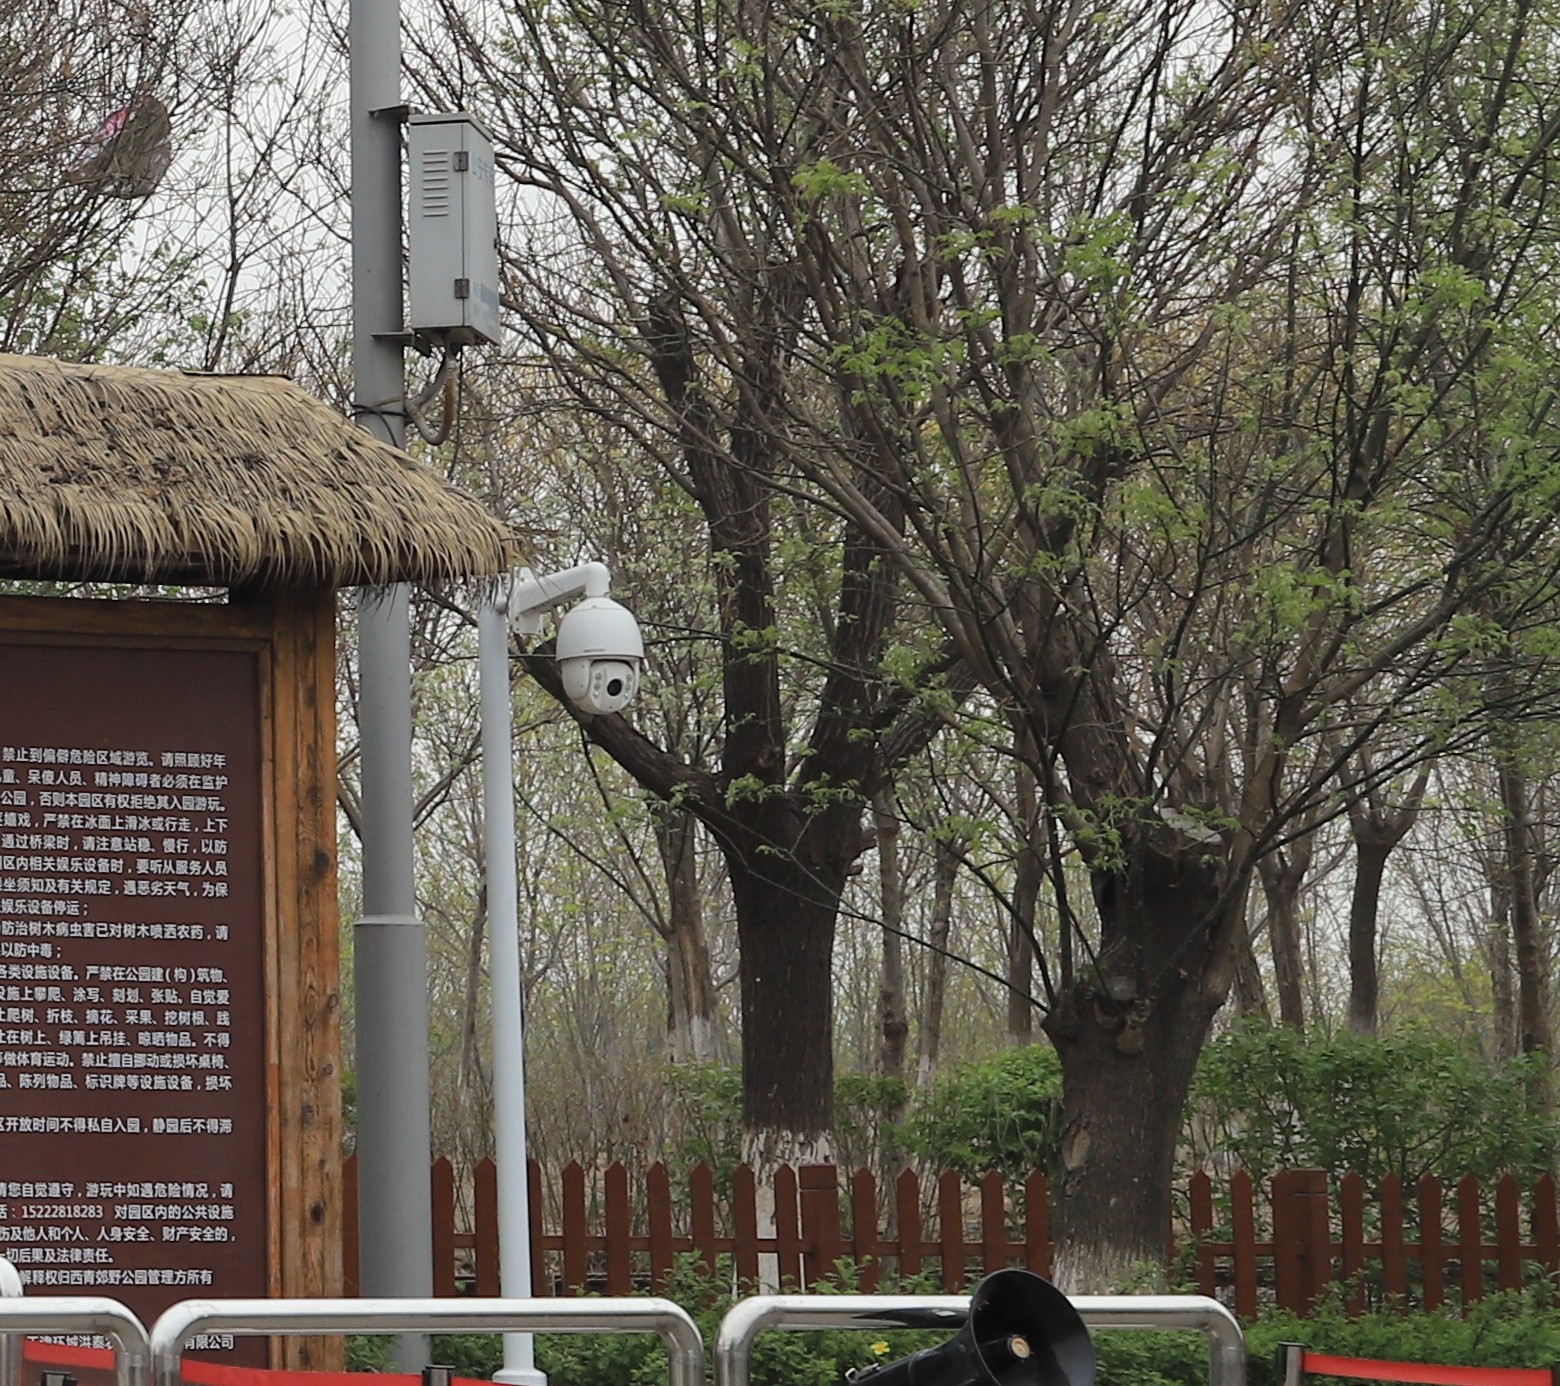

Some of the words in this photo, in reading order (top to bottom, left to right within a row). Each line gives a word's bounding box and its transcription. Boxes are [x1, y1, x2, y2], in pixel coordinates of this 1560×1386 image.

[114, 1205, 234, 1220] 对园区内的公共设施
